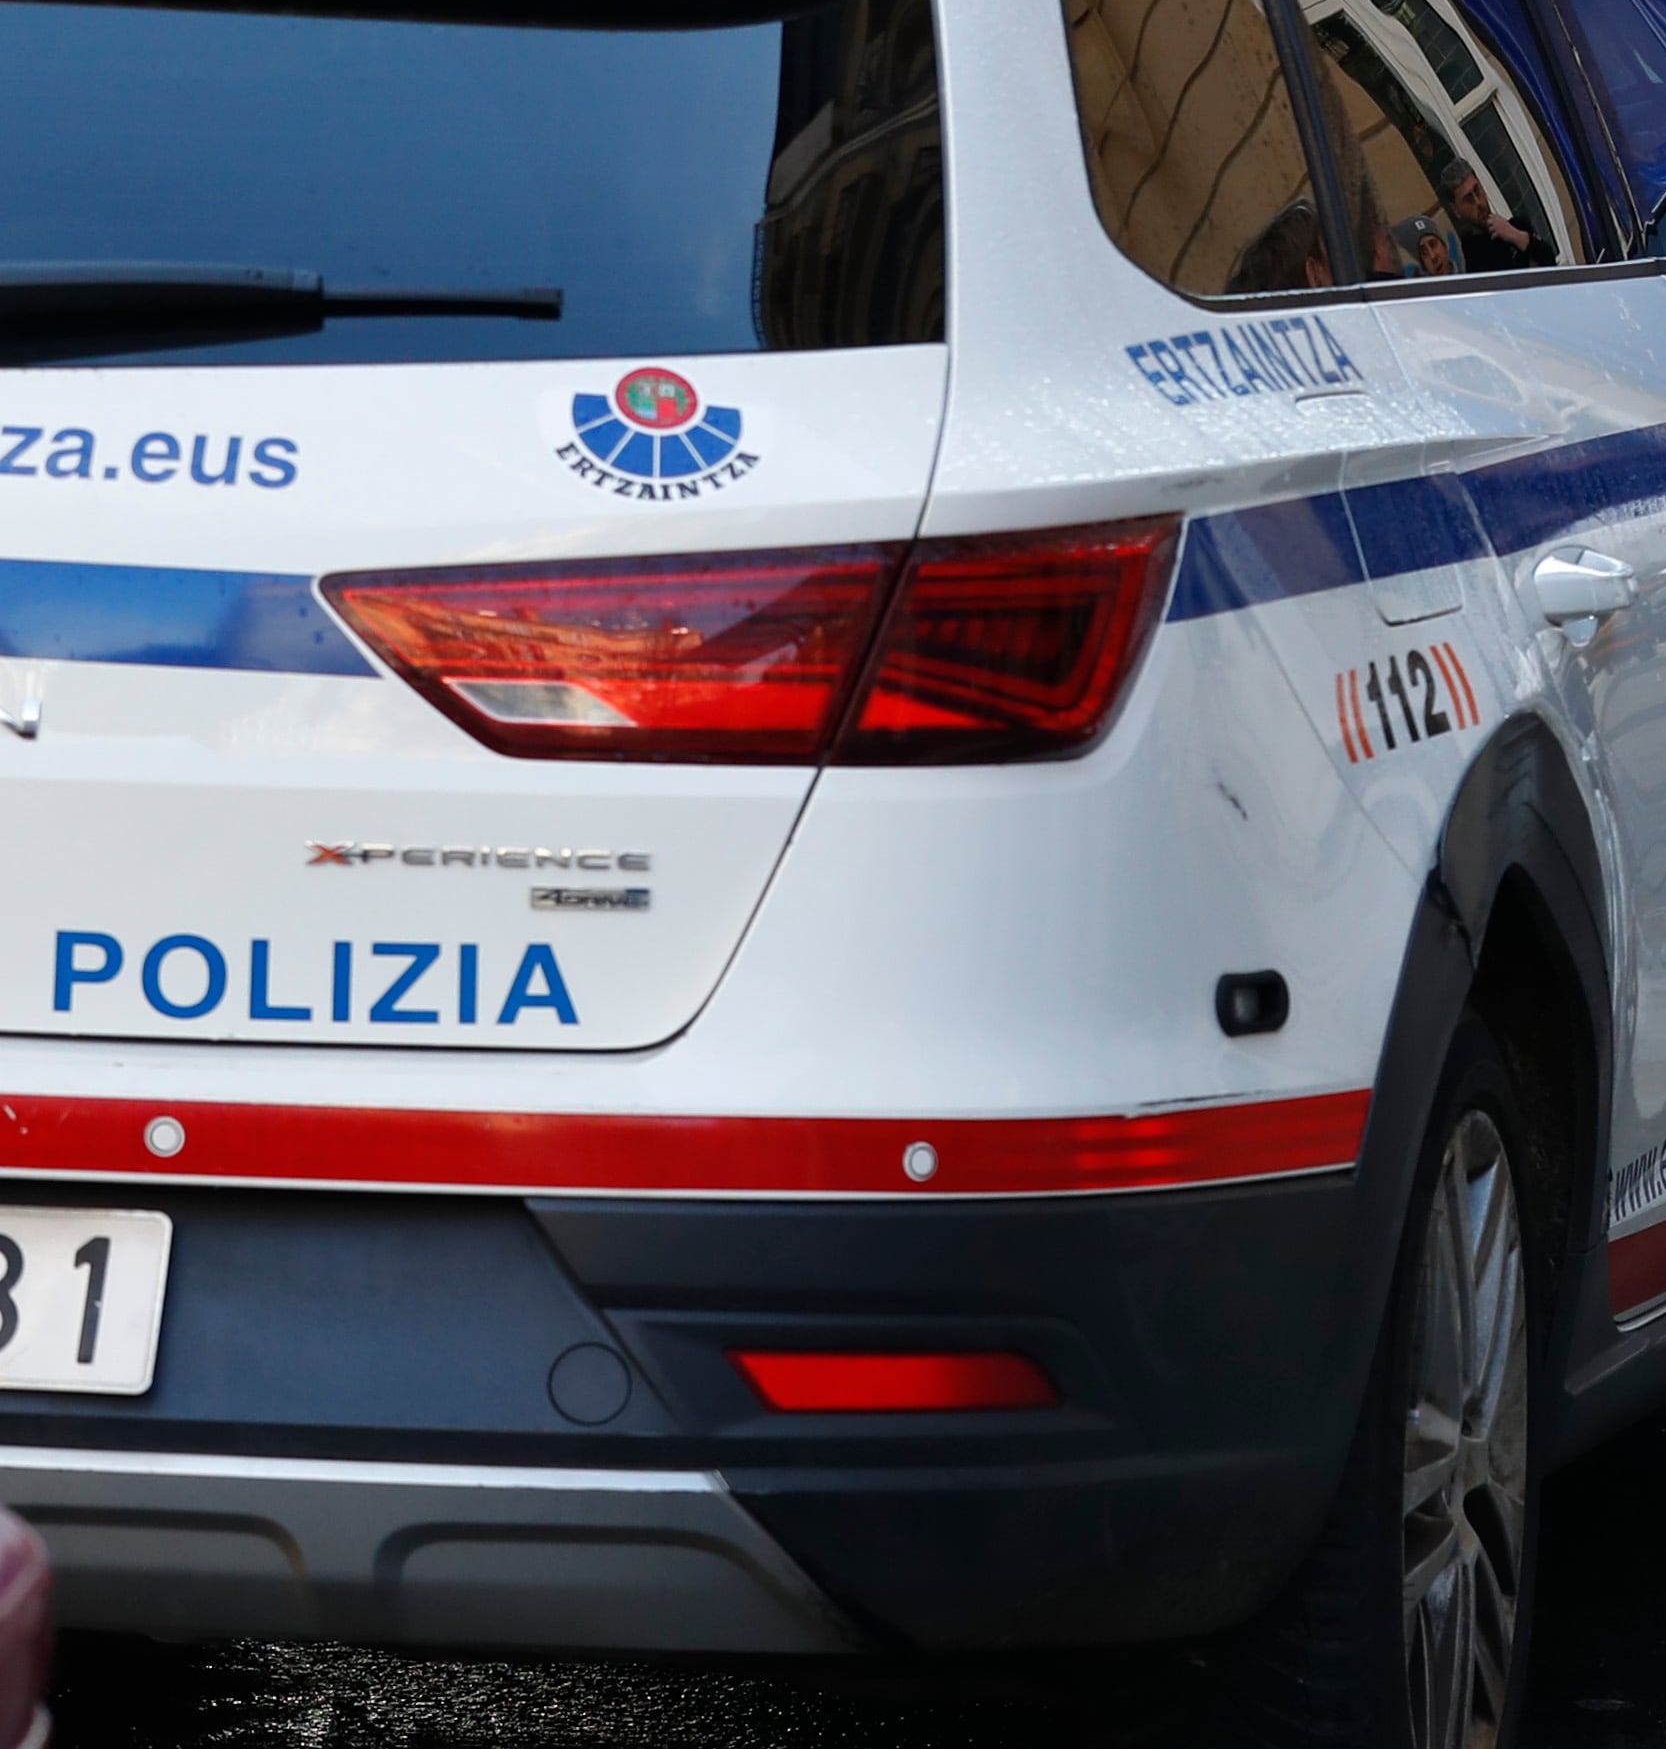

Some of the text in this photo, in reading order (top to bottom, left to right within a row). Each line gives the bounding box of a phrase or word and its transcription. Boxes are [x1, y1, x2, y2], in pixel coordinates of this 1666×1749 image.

[1124, 314, 1364, 406] ERTZAINTZA
[555, 441, 760, 501] ERTZAINTZA
[53, 931, 580, 1027] POLIZIA
